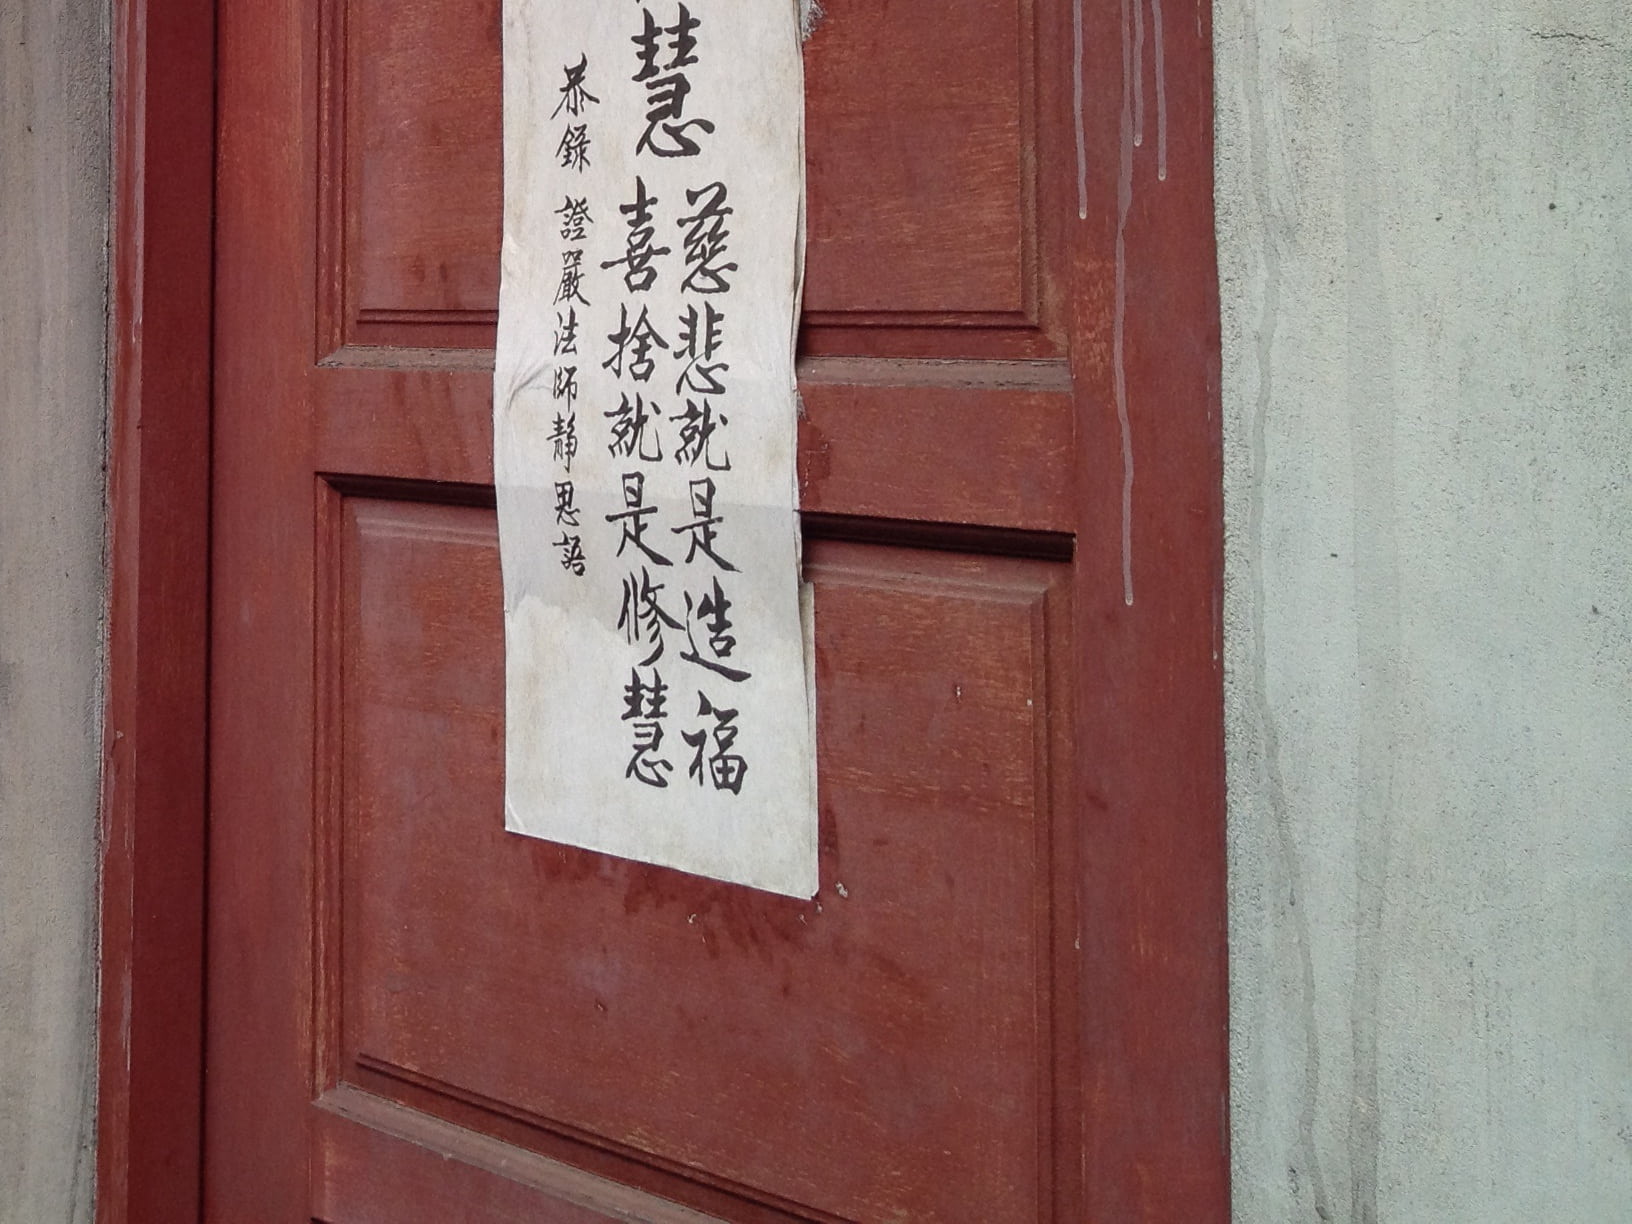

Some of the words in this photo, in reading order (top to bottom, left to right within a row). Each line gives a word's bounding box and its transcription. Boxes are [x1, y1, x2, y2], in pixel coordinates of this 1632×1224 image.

[600, 175, 686, 789] 喜捨就是修慧
[668, 180, 752, 796] 慈悲就是造福
